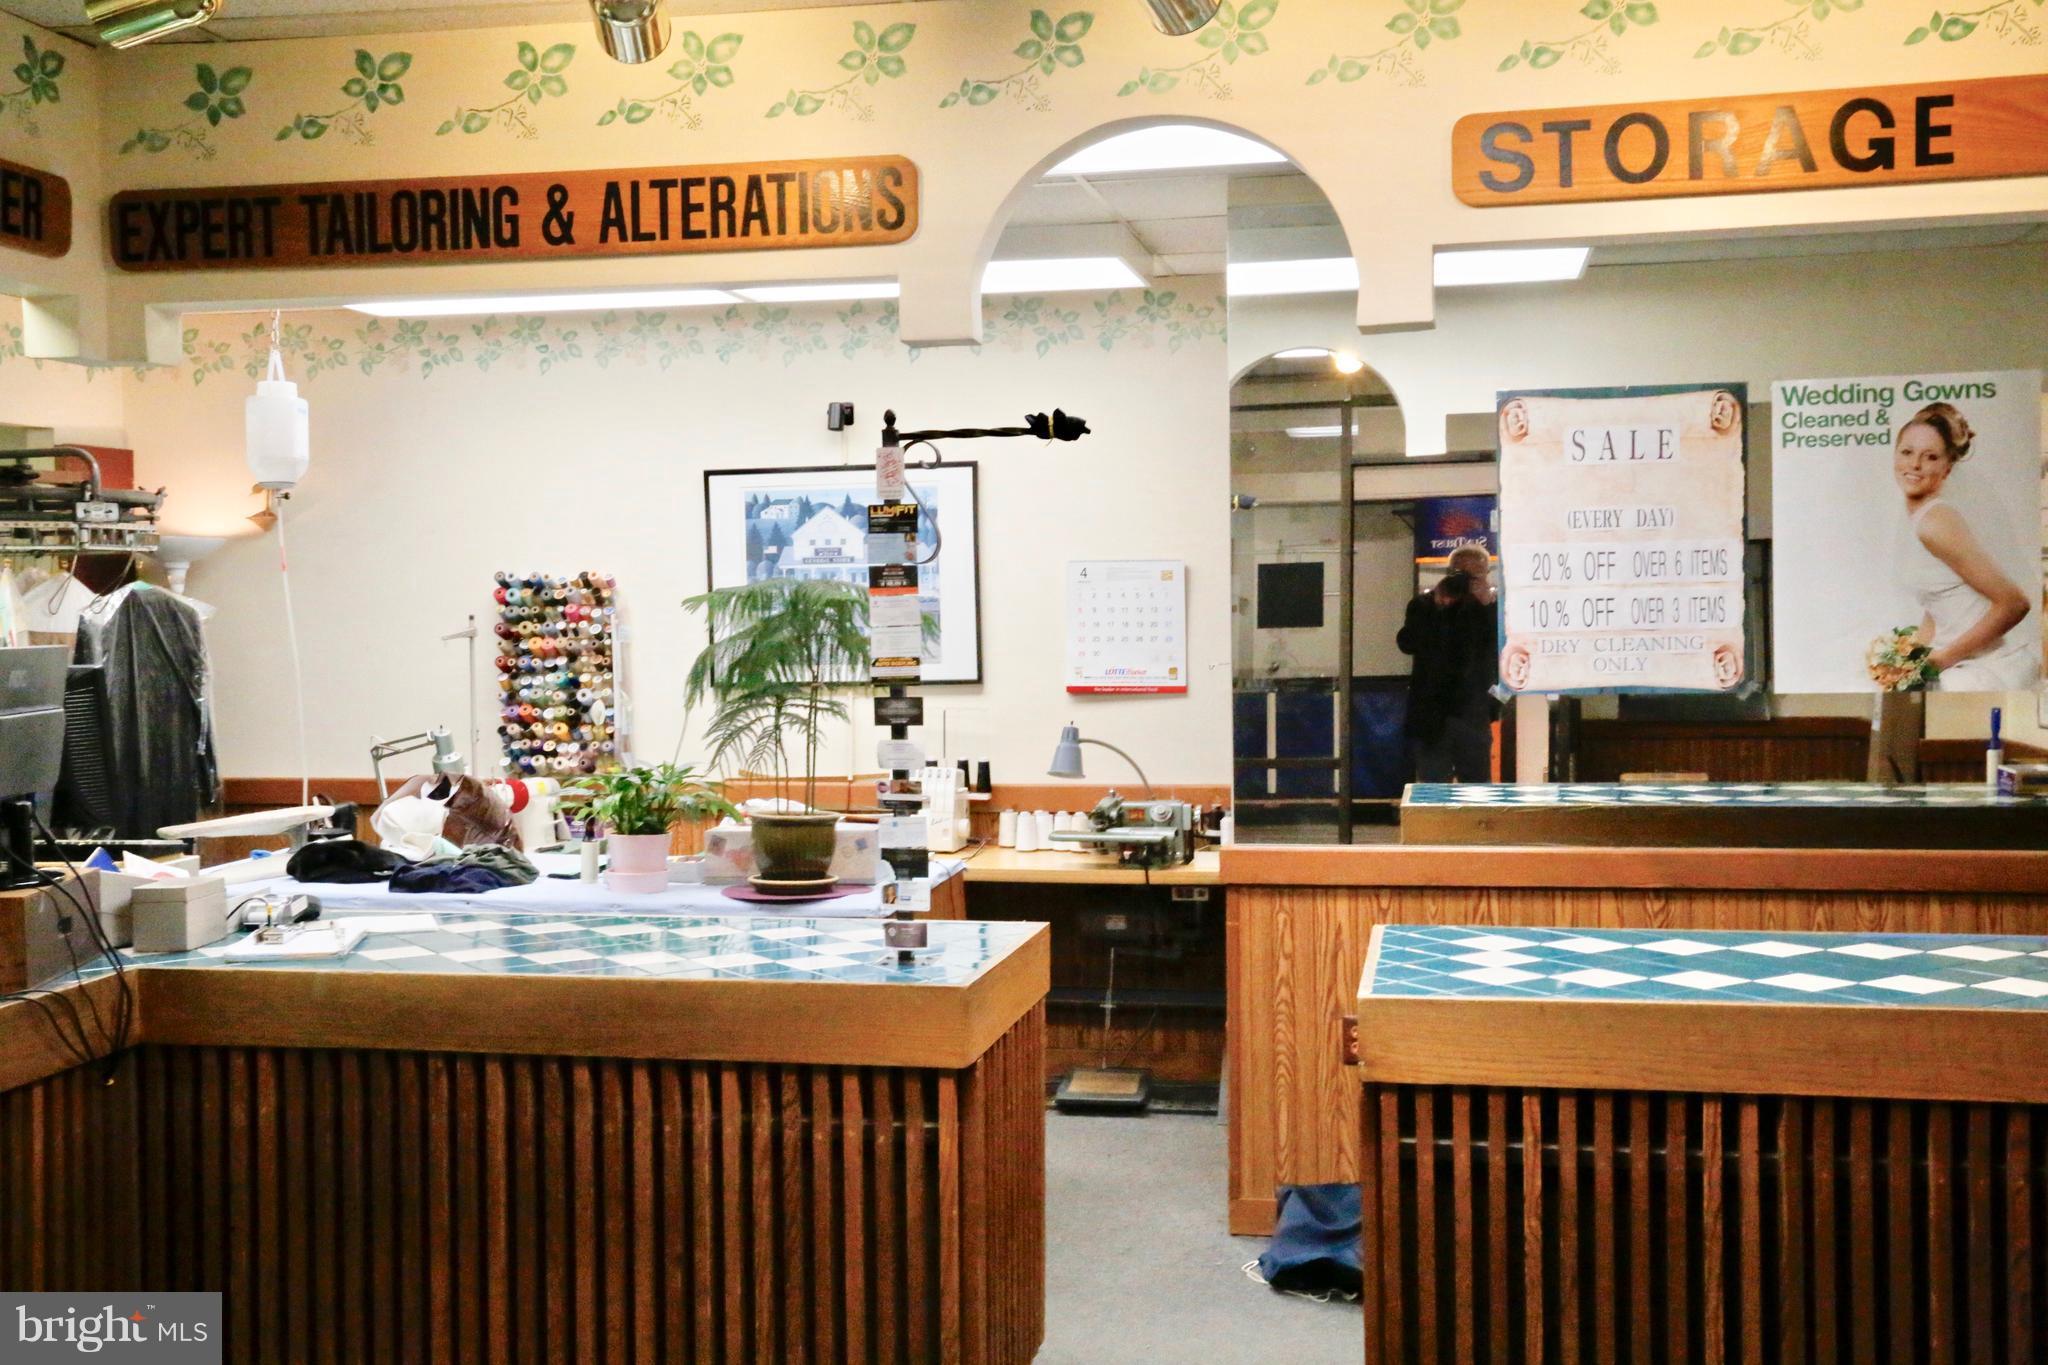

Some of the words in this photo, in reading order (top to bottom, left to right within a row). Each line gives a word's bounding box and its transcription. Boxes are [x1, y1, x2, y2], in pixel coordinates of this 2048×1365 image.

[1478, 93, 1955, 193] STORAGE
[118, 196, 284, 264] EXPERT
[299, 186, 520, 257] TAILORING
[541, 183, 575, 246] &
[600, 166, 906, 245] ALTERATIONS
[1781, 383, 1895, 408] Wedding
[1903, 380, 1997, 402] Gowns
[1781, 410, 1869, 430] Cleaned
[1875, 409, 1890, 426] &
[1781, 429, 1891, 448] Preserved
[1567, 509, 1624, 530] (EVERY
[1636, 507, 1675, 529] DAY)
[1079, 567, 1088, 579] 4
[1583, 551, 1617, 581] OFF
[1633, 551, 1668, 578] OVER
[1674, 550, 1682, 576] 6
[1690, 548, 1728, 576] ITEMS
[1582, 598, 1616, 628] OFF
[1631, 597, 1665, 625] OVER
[1672, 597, 1680, 624] 3
[1687, 595, 1726, 624] ITEMS
[1541, 638, 1581, 654] DRY
[1593, 635, 1705, 652] CLEANING
[1592, 656, 1648, 673] ONLY
